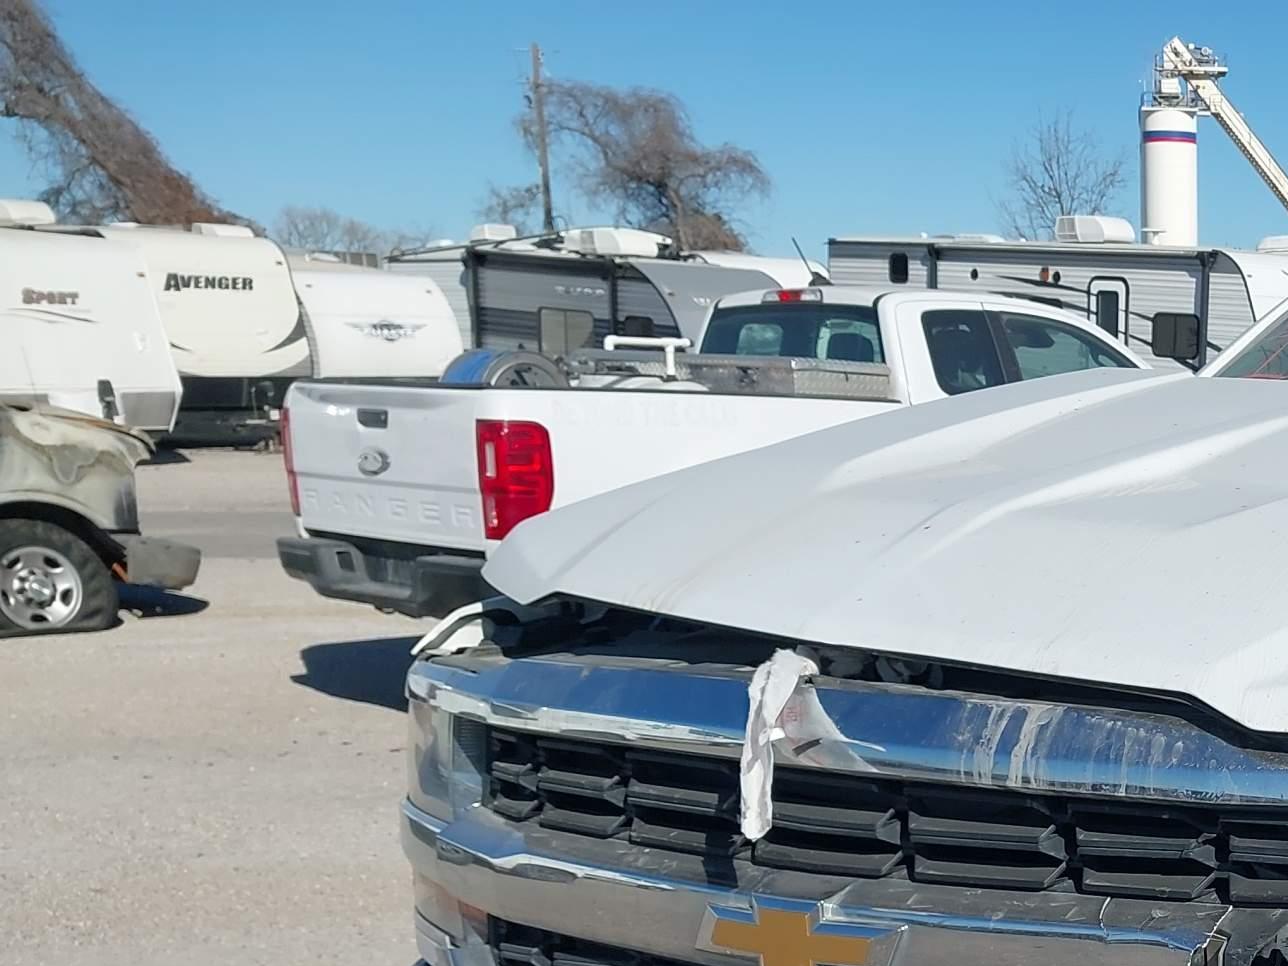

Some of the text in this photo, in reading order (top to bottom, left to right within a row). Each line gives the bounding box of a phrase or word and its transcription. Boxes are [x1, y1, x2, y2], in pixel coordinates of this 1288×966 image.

[164, 272, 254, 291] AVENGER
[22, 287, 79, 304] SPORT
[304, 488, 475, 528] RANGER
